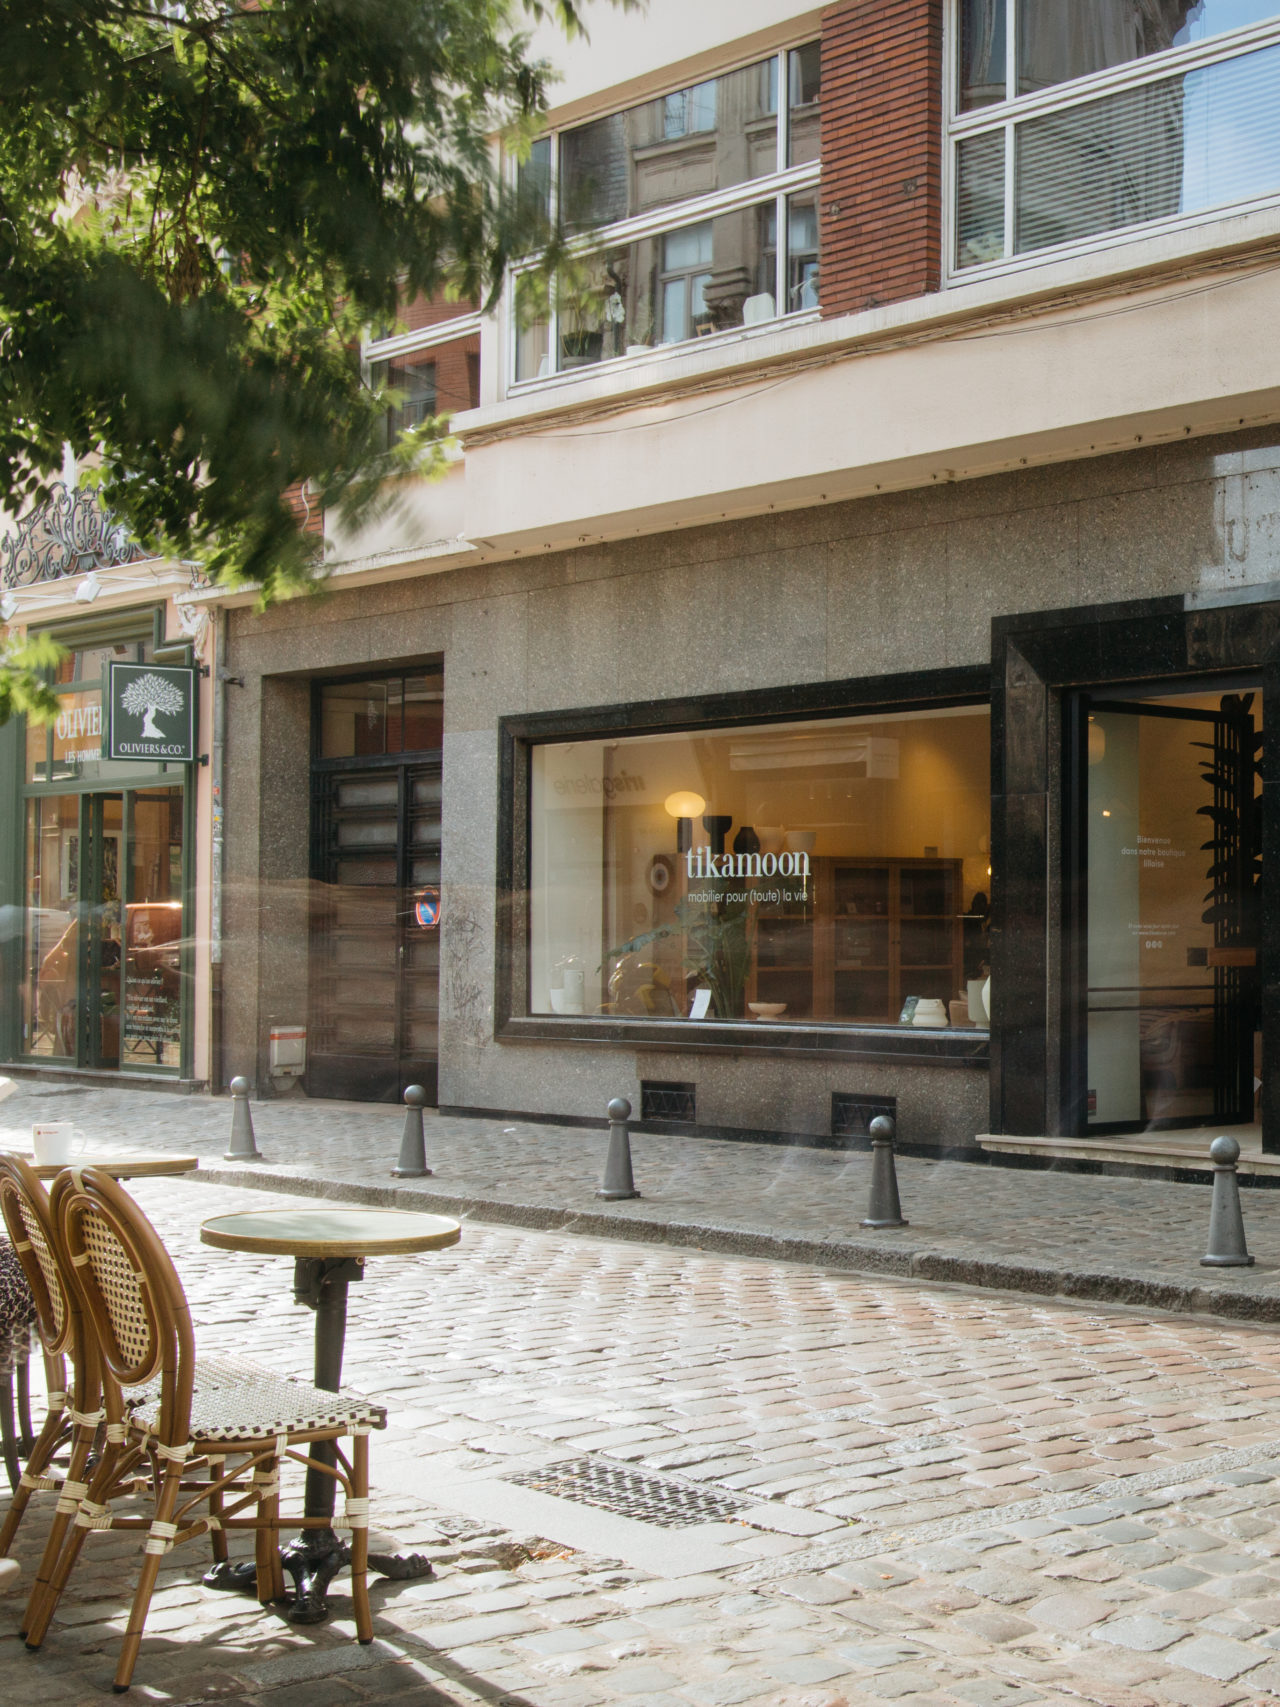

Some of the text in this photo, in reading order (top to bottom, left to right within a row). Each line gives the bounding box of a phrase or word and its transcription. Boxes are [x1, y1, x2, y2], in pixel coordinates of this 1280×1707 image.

[57, 705, 102, 740] OLIVIE
[685, 846, 811, 878] tikamoon
[688, 888, 808, 905] mobilier pour (toute) la vie
